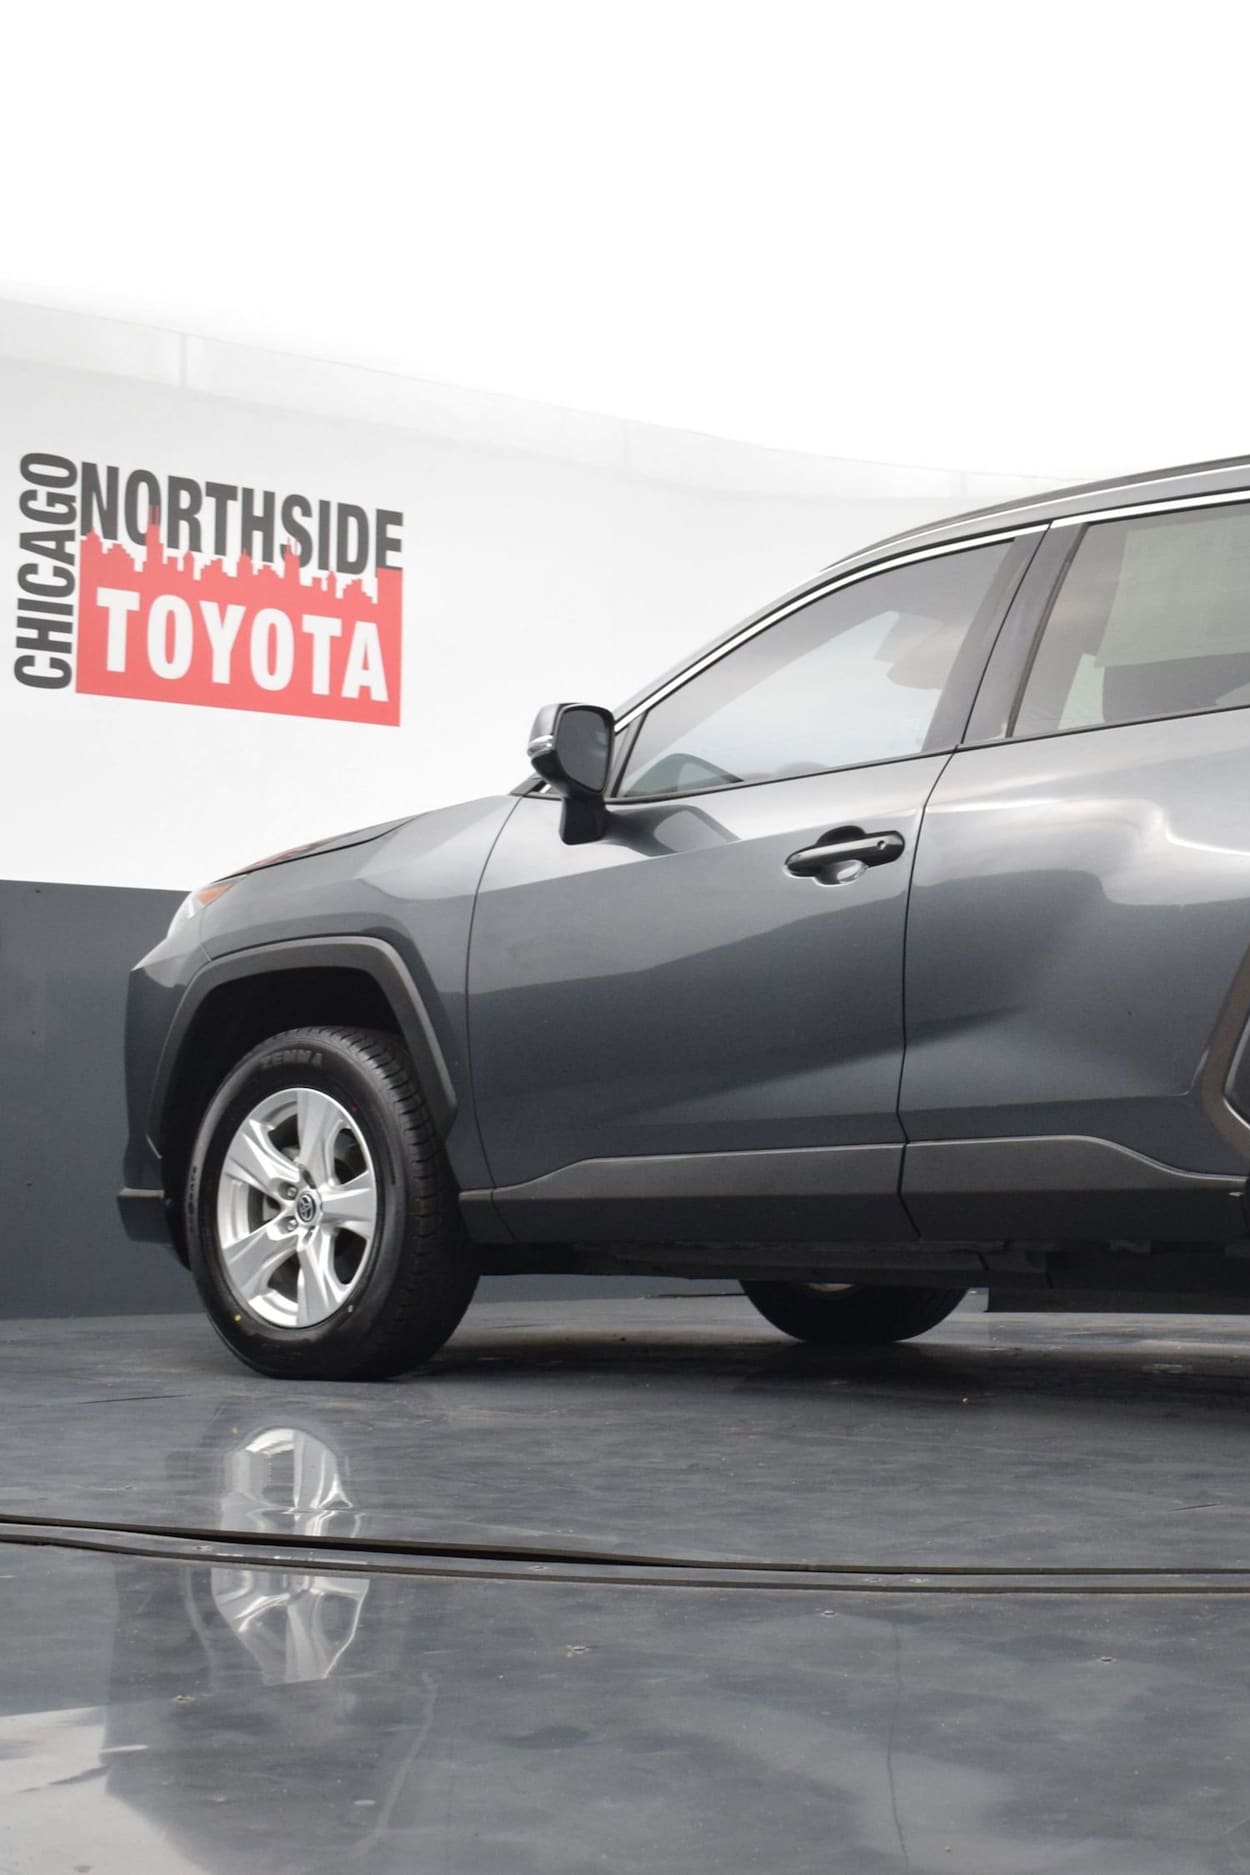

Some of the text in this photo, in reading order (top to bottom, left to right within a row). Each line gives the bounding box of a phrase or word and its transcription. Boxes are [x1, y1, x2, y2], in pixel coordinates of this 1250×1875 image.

[14, 452, 78, 690] CHICAGO
[80, 461, 404, 577] NORTHSIDE
[96, 586, 390, 702] TOYOTA
